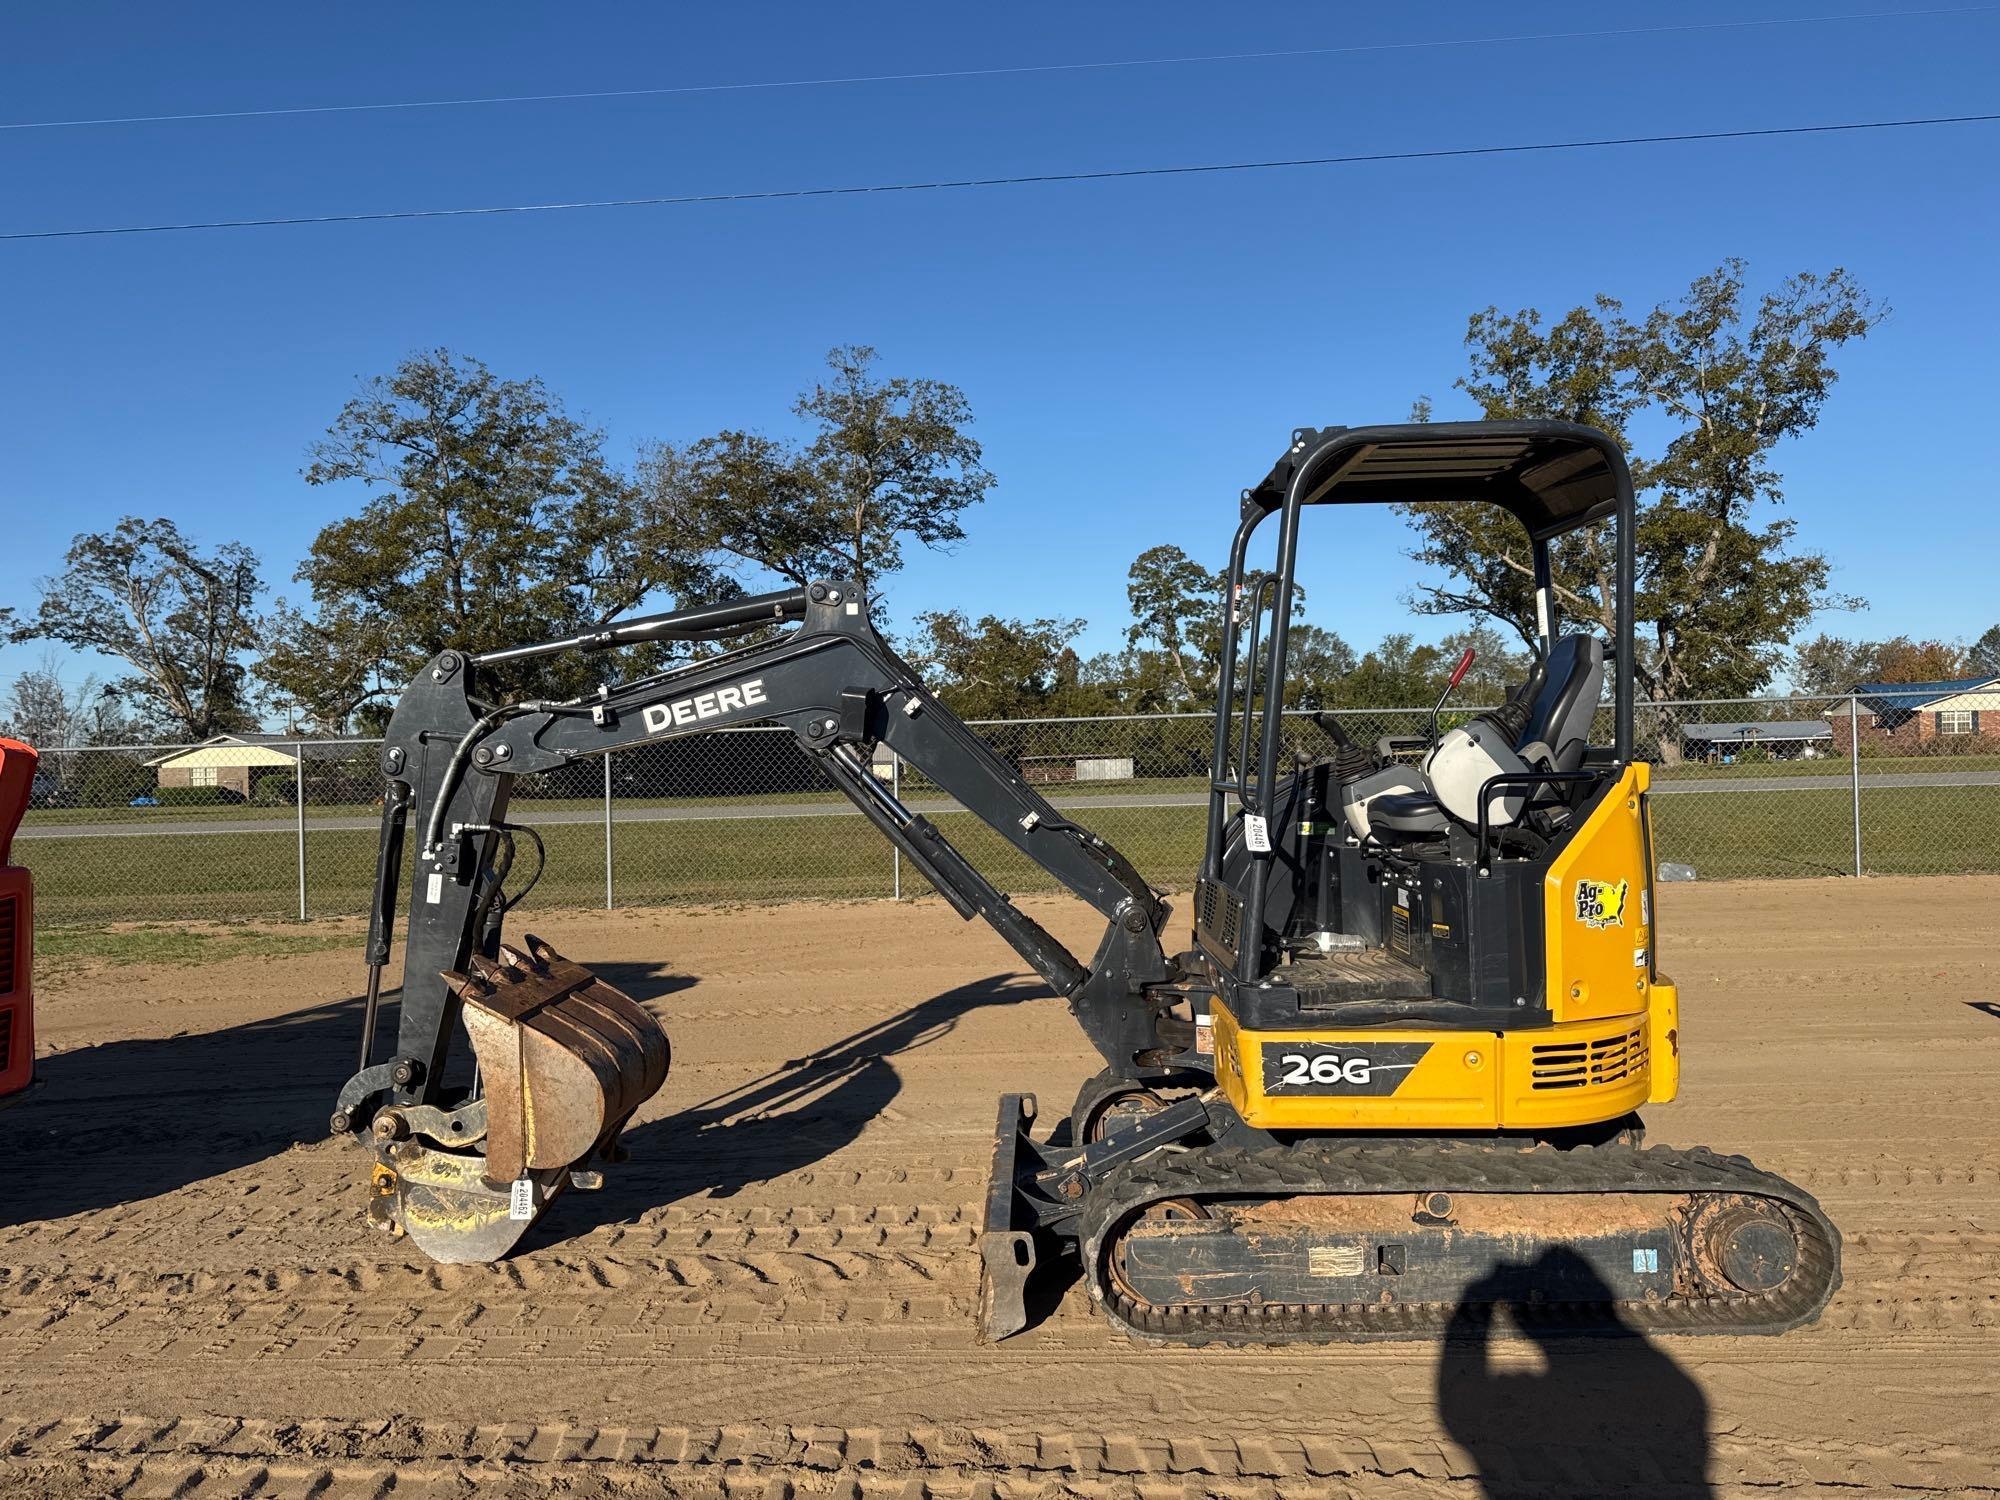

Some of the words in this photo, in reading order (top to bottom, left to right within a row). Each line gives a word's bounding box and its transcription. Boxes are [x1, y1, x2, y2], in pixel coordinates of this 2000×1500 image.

[642, 678, 767, 734] DEERE
[1252, 823, 1266, 848] 204461
[1578, 900, 1604, 918] Pro
[1281, 1053, 1371, 1085] 26G
[518, 1188, 529, 1215] 204462
